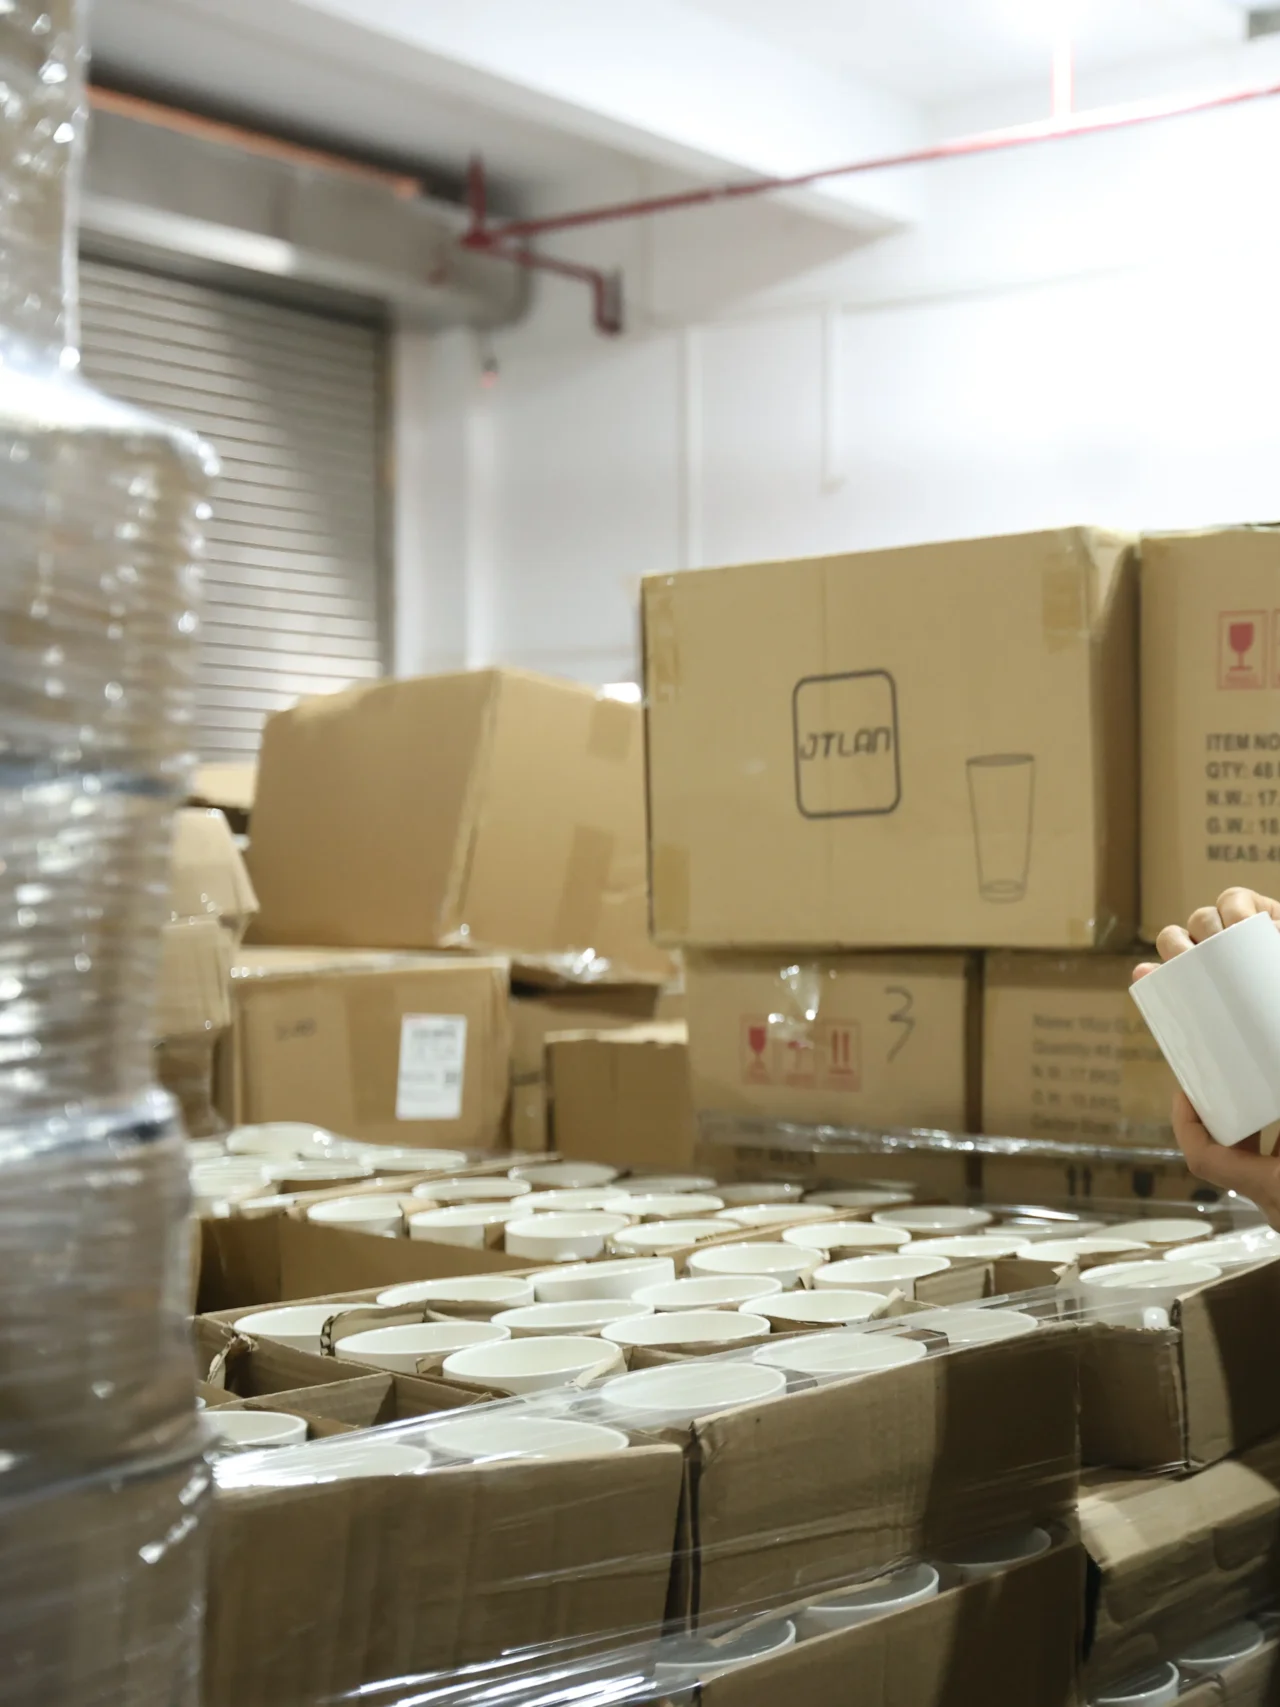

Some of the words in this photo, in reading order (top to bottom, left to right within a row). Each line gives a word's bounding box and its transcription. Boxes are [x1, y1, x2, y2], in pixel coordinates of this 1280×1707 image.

[1206, 733, 1249, 751] ITEM
[1206, 761, 1247, 779] QTY:
[1252, 761, 1274, 779] 48
[884, 984, 916, 1064] 3
